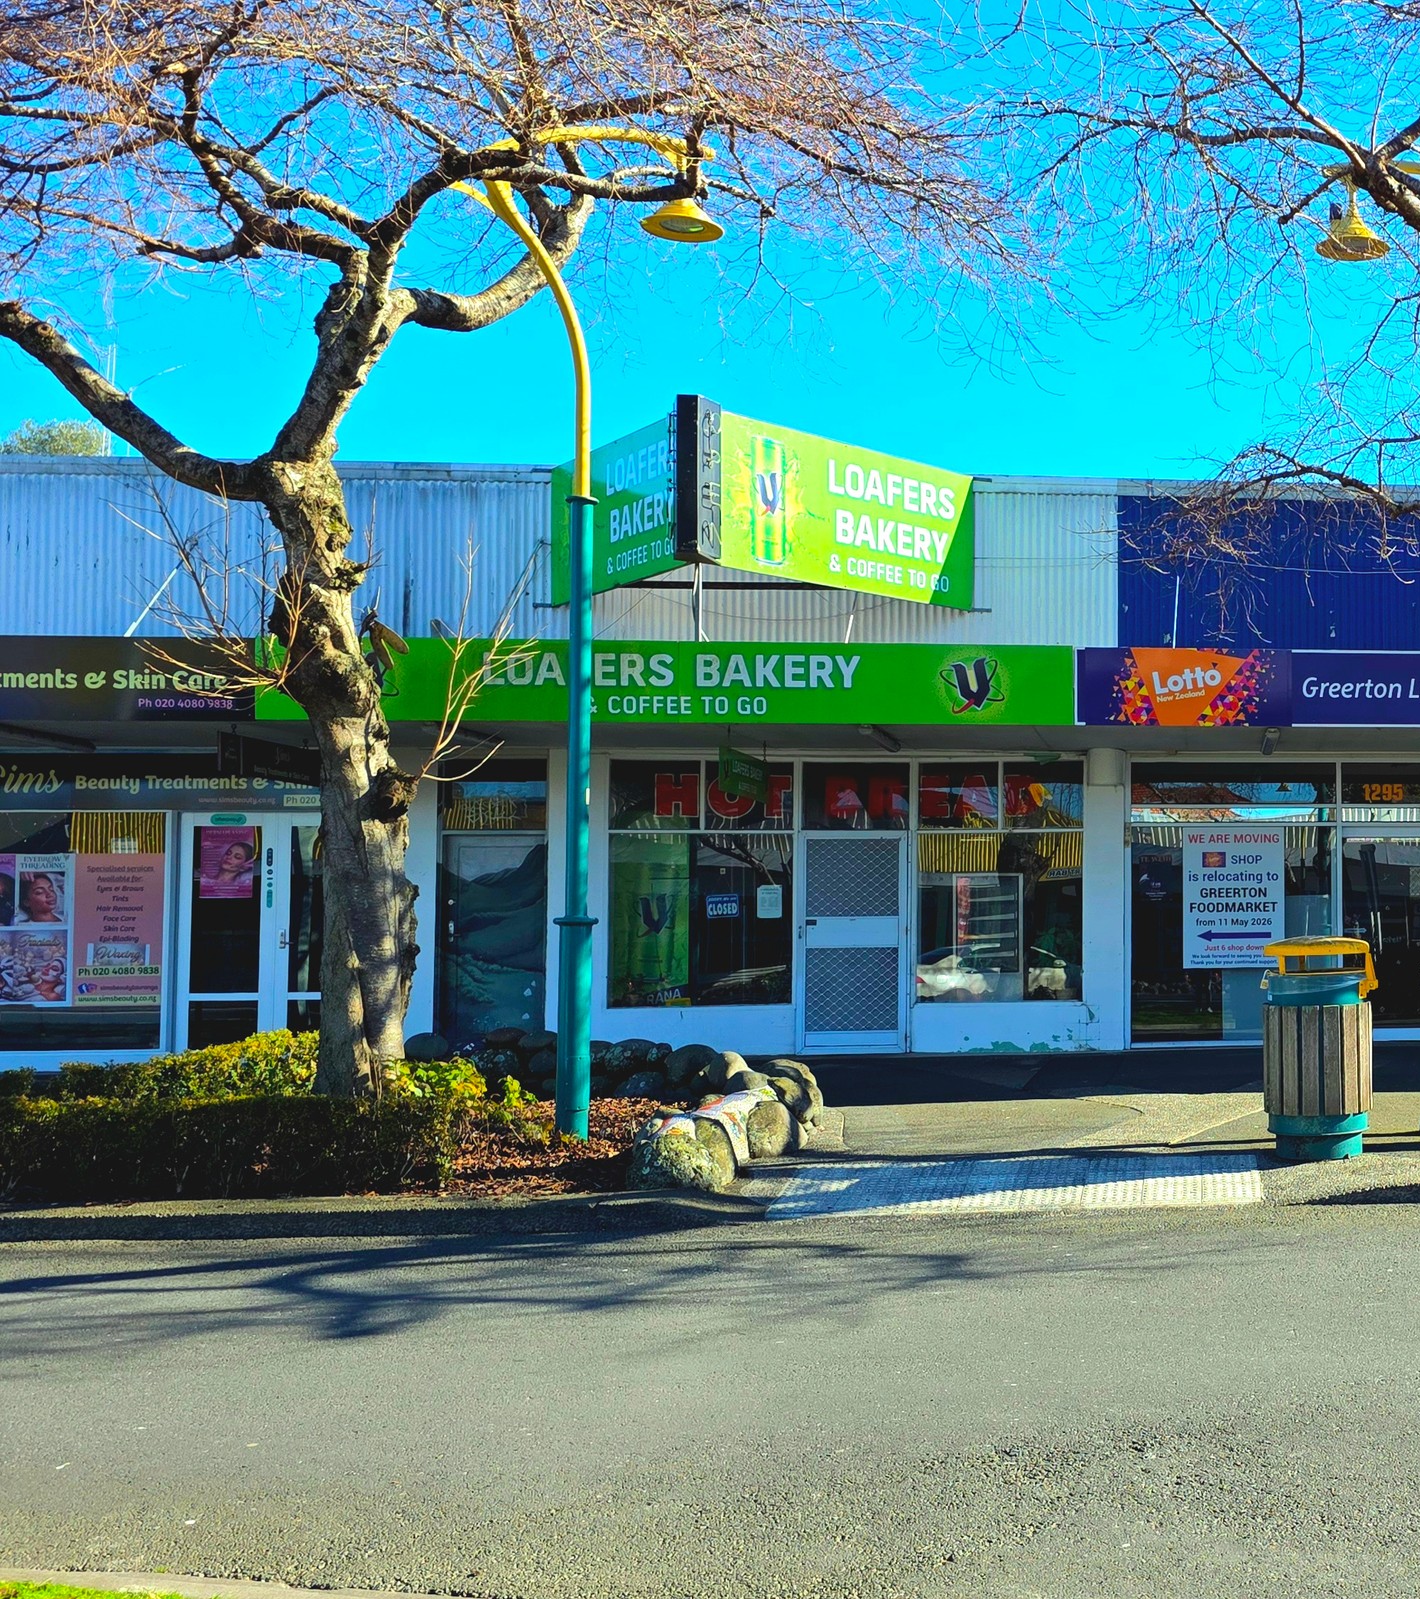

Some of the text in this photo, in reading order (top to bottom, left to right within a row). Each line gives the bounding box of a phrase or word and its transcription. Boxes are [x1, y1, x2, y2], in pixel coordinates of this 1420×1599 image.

[828, 459, 955, 520] LOAFERS
[610, 489, 674, 543] BAKERY
[835, 509, 949, 563] BAKERY
[607, 557, 614, 575] &
[616, 545, 648, 571] COFFEE
[650, 541, 662, 560] TO
[829, 554, 949, 592] & COFFEE TO GO
[84, 670, 107, 689] &
[113, 669, 166, 689] Skin
[172, 671, 228, 690] Care
[482, 653, 861, 688] LOAERS BAKERY
[1152, 666, 1222, 694] Lotto
[1302, 676, 1402, 699] Greerton
[138, 698, 152, 708] Ph
[155, 699, 175, 708] 020
[177, 699, 205, 708] 4080
[1156, 689, 1206, 703] New Zealand
[608, 696, 692, 715] COFFEE
[700, 697, 729, 715] TO
[737, 696, 767, 715] GO
[75, 775, 140, 794] Beauty
[145, 774, 247, 790] Treatments
[252, 777, 269, 789] &
[1363, 783, 1404, 801] 1295
[286, 796, 298, 804] Ph
[301, 796, 316, 804] 020
[655, 774, 792, 818] HOT
[1188, 833, 1280, 843] WE ARE MOVING
[1231, 854, 1262, 864] SHOP
[1188, 870, 1279, 884] is relocating to
[1200, 887, 1267, 898] GREERTON
[708, 902, 738, 915] CLOSED
[1189, 902, 1278, 913] FOODMARKET
[1196, 918, 1272, 927] from 11 May 2026
[1227, 944, 1244, 952] shop
[78, 966, 159, 976] Ph 020 4080 9838
